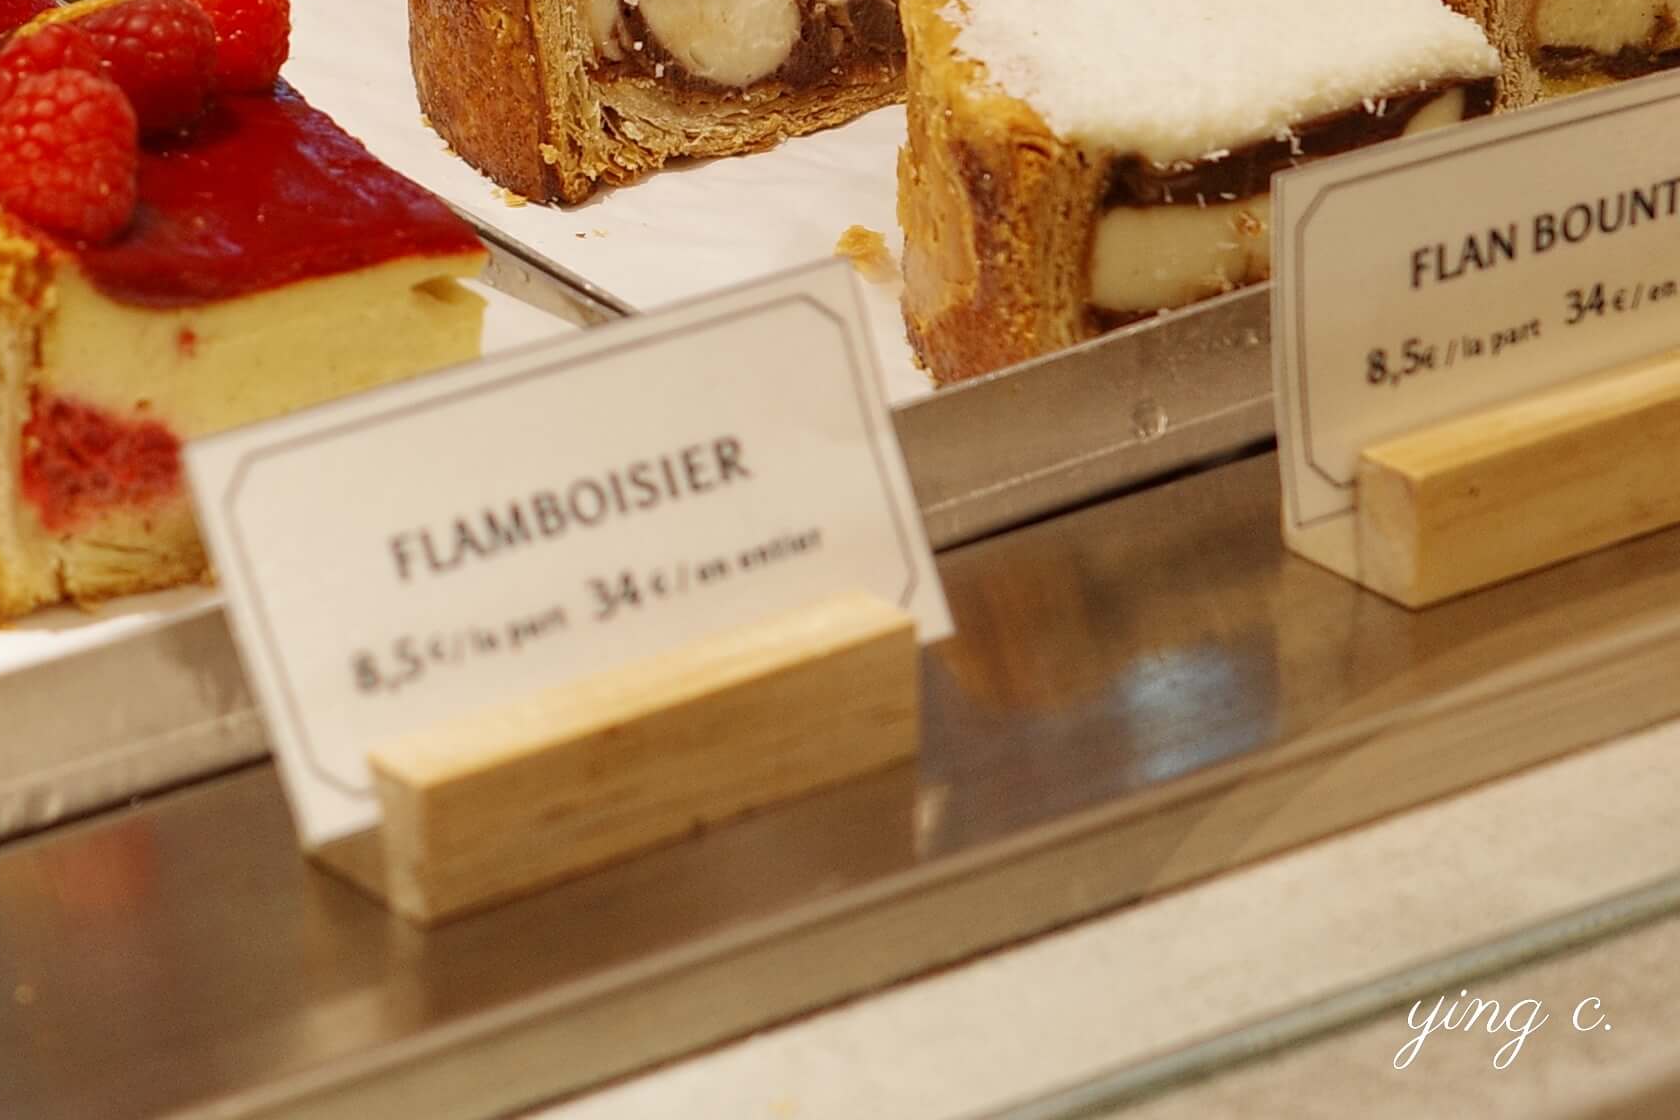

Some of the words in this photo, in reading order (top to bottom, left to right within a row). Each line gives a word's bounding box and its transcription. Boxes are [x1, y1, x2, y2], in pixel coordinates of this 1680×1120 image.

[1409, 223, 1518, 291] FLAN
[1490, 317, 1542, 356] part
[388, 433, 752, 583] FLAMBOISIER
